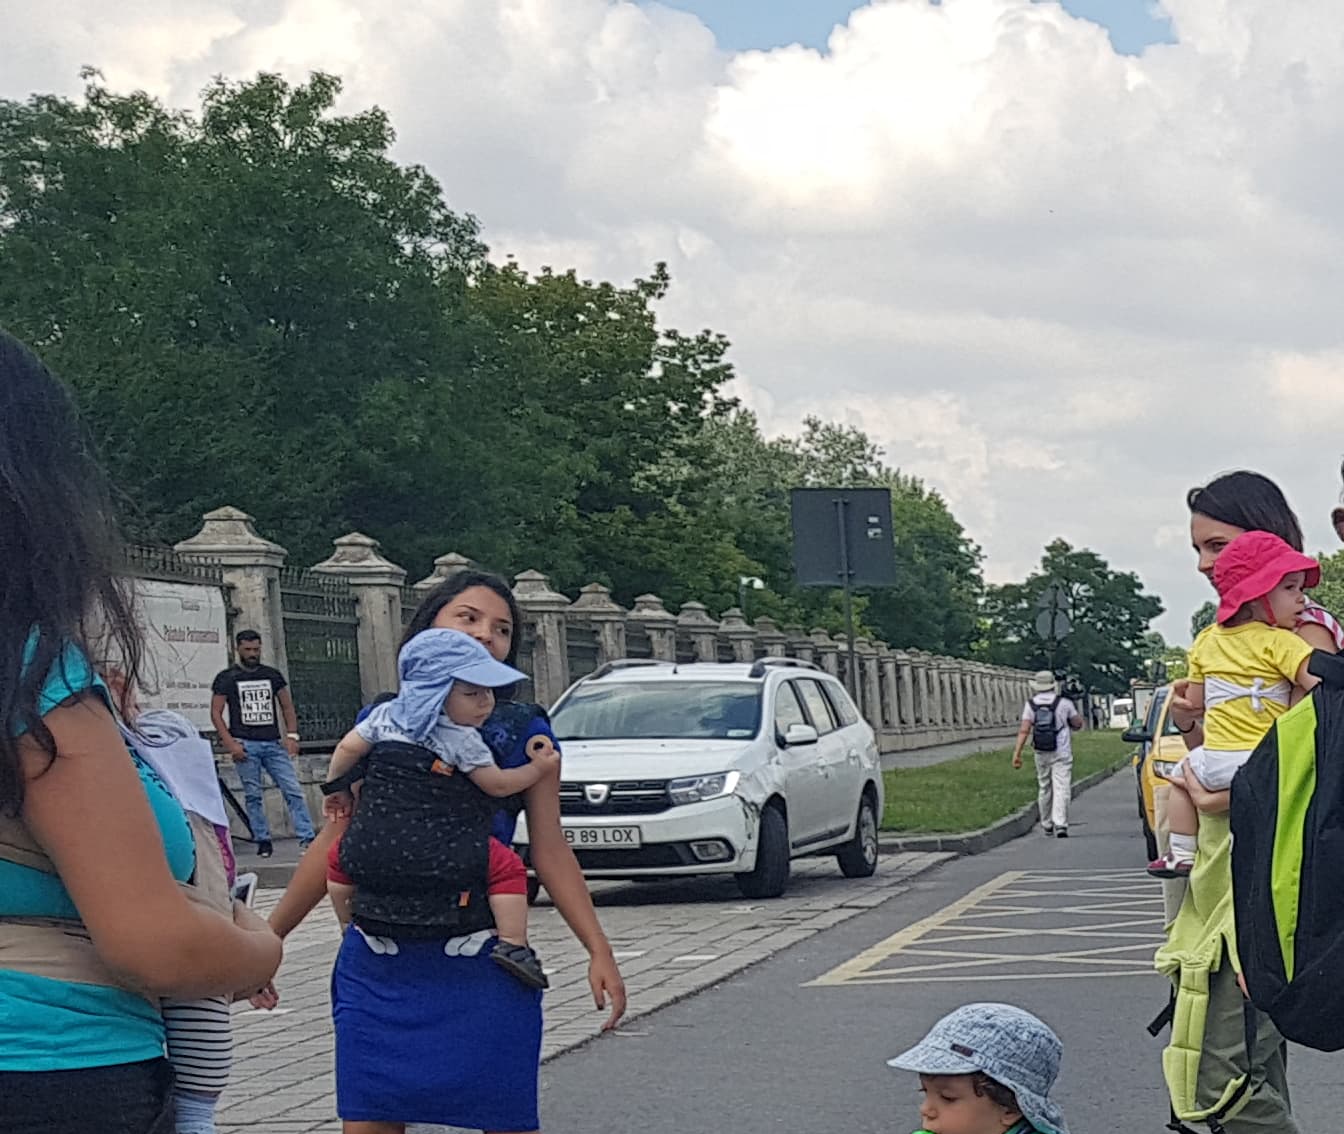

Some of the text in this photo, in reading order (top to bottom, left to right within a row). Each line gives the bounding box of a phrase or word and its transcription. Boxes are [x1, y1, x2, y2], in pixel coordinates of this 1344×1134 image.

[244, 690, 269, 701] STEP
[580, 830, 598, 843] 89
[602, 829, 633, 842] LOX
